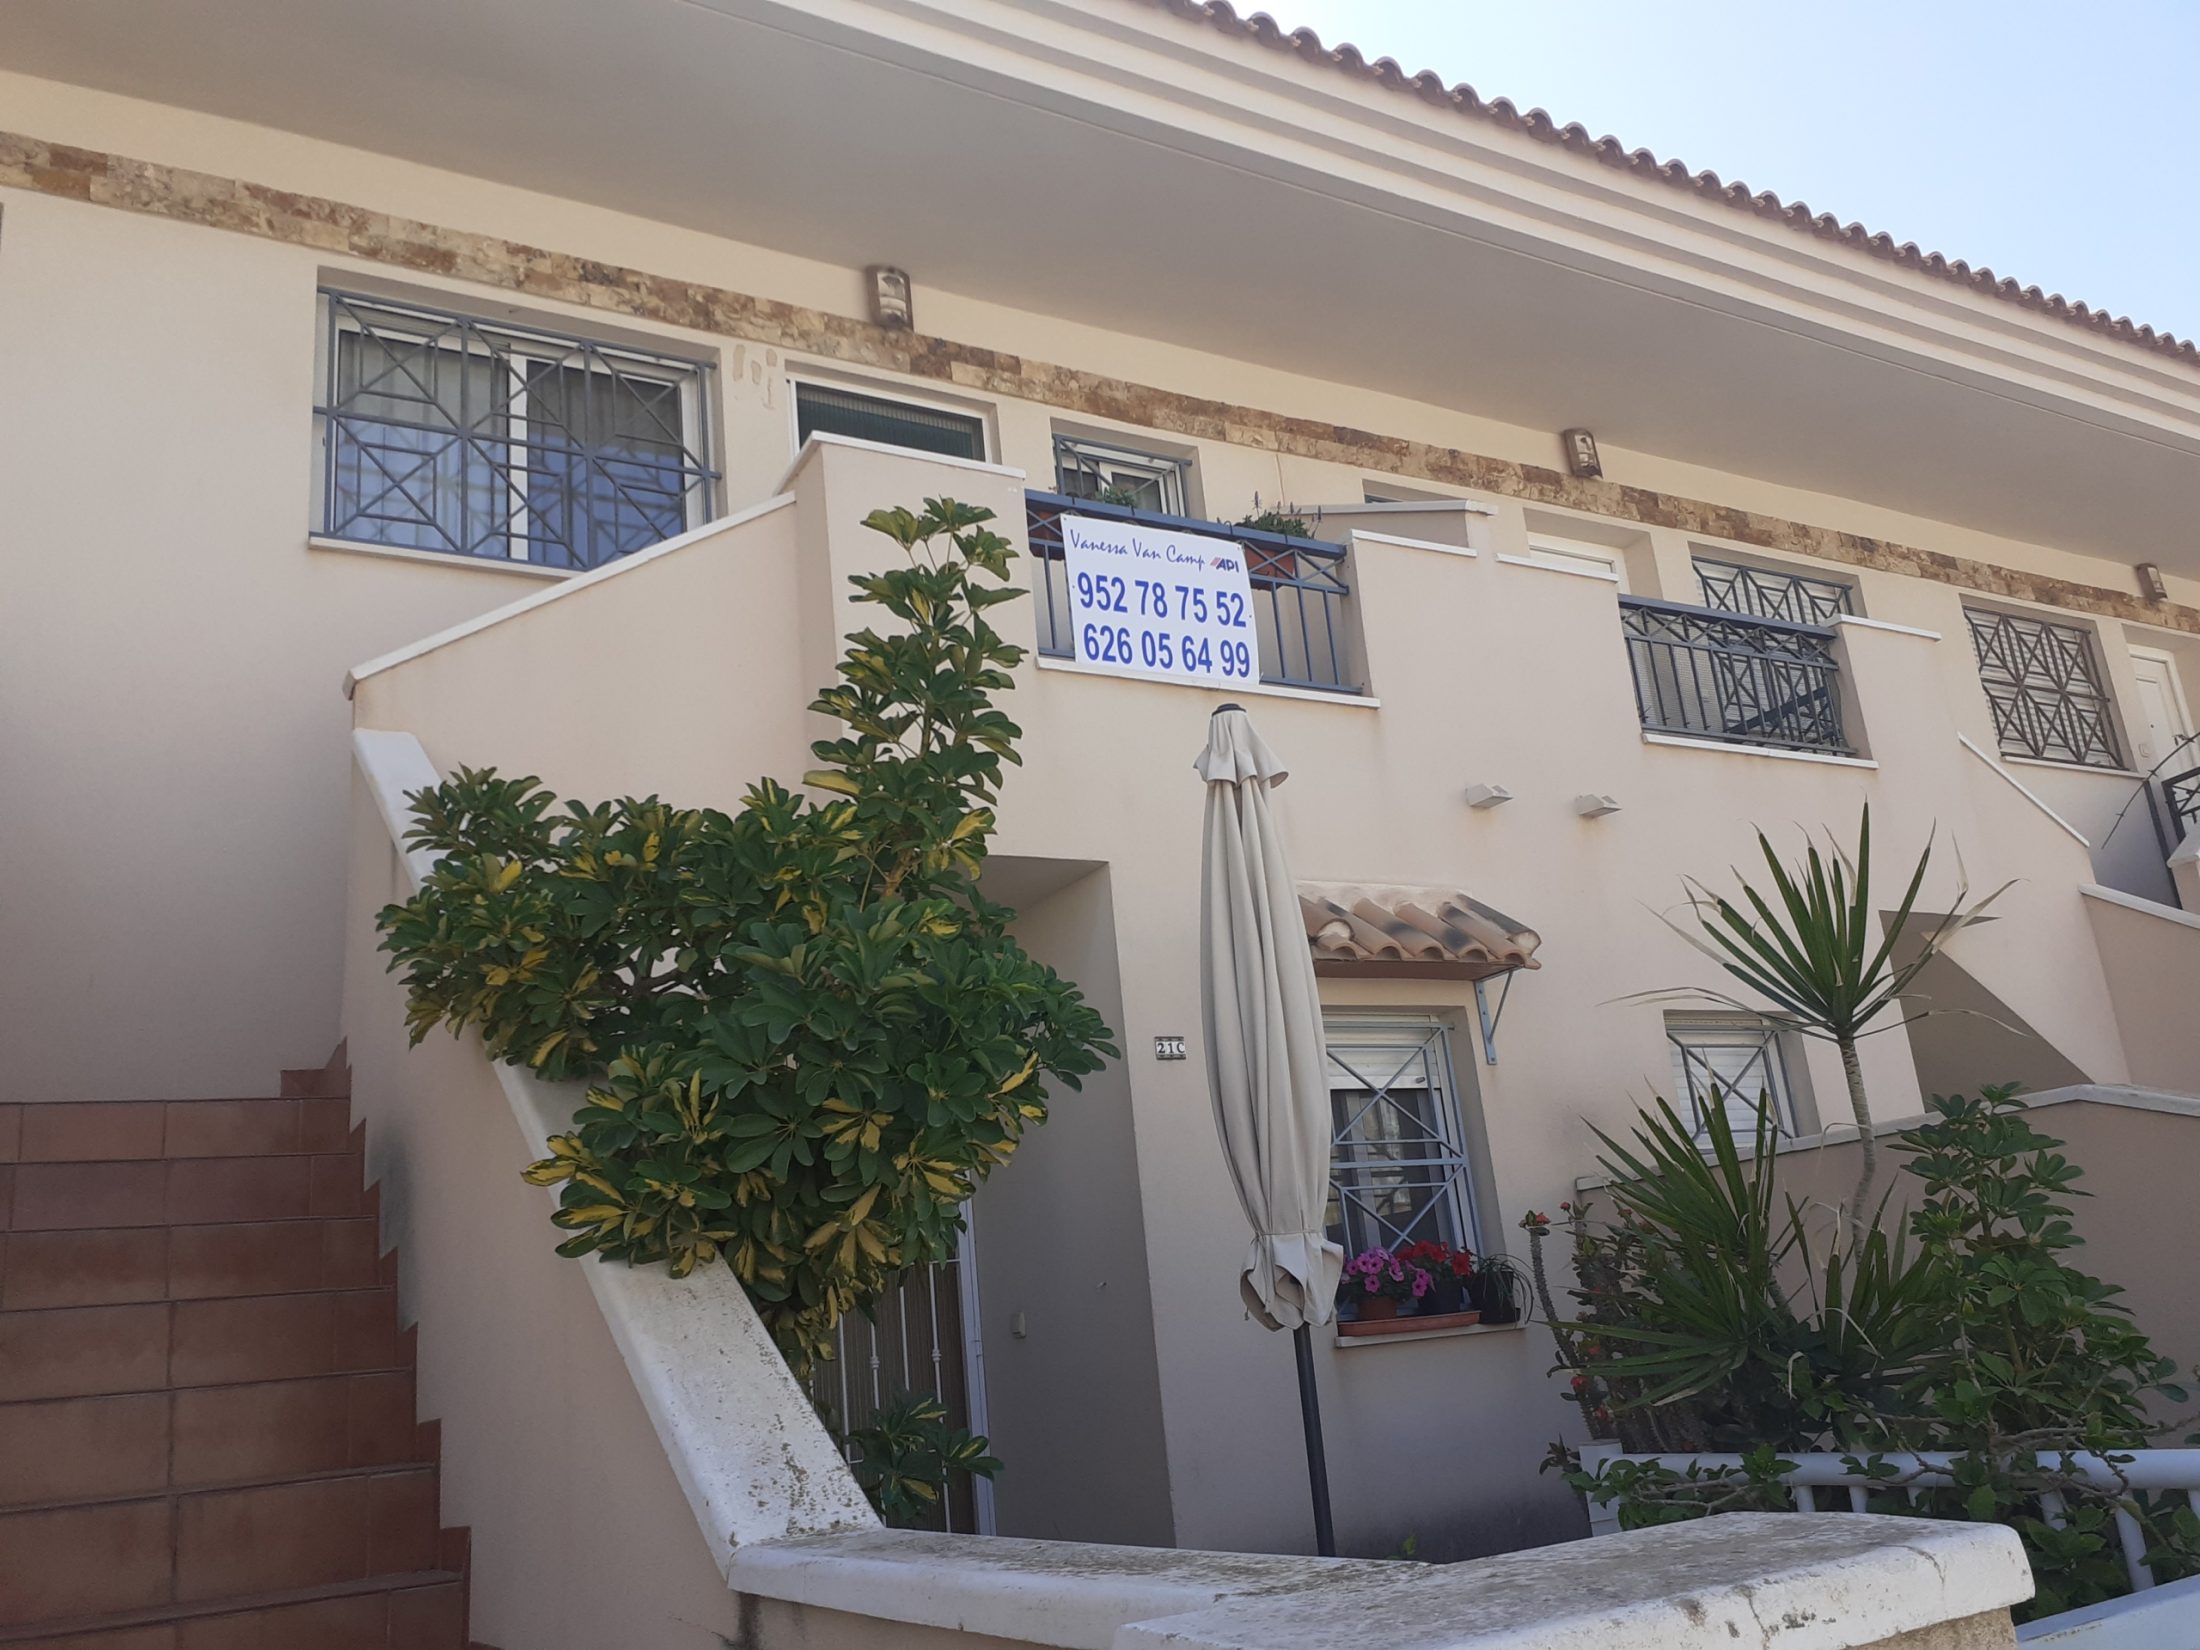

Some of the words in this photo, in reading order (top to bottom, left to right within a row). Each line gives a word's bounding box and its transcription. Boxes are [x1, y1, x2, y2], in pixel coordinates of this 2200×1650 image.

[1070, 529, 1128, 556] Vanessa
[1132, 537, 1161, 560] Van
[1166, 544, 1205, 572] Camp
[1077, 572, 1128, 613] 952
[1135, 580, 1168, 618] 78
[1175, 585, 1208, 623] 75
[1216, 591, 1247, 628] 52
[1084, 623, 1133, 665] 626
[1141, 630, 1173, 669] 05
[1181, 635, 1213, 673] 64
[1220, 640, 1250, 678] 99
[1157, 1042, 1185, 1054] 21C
